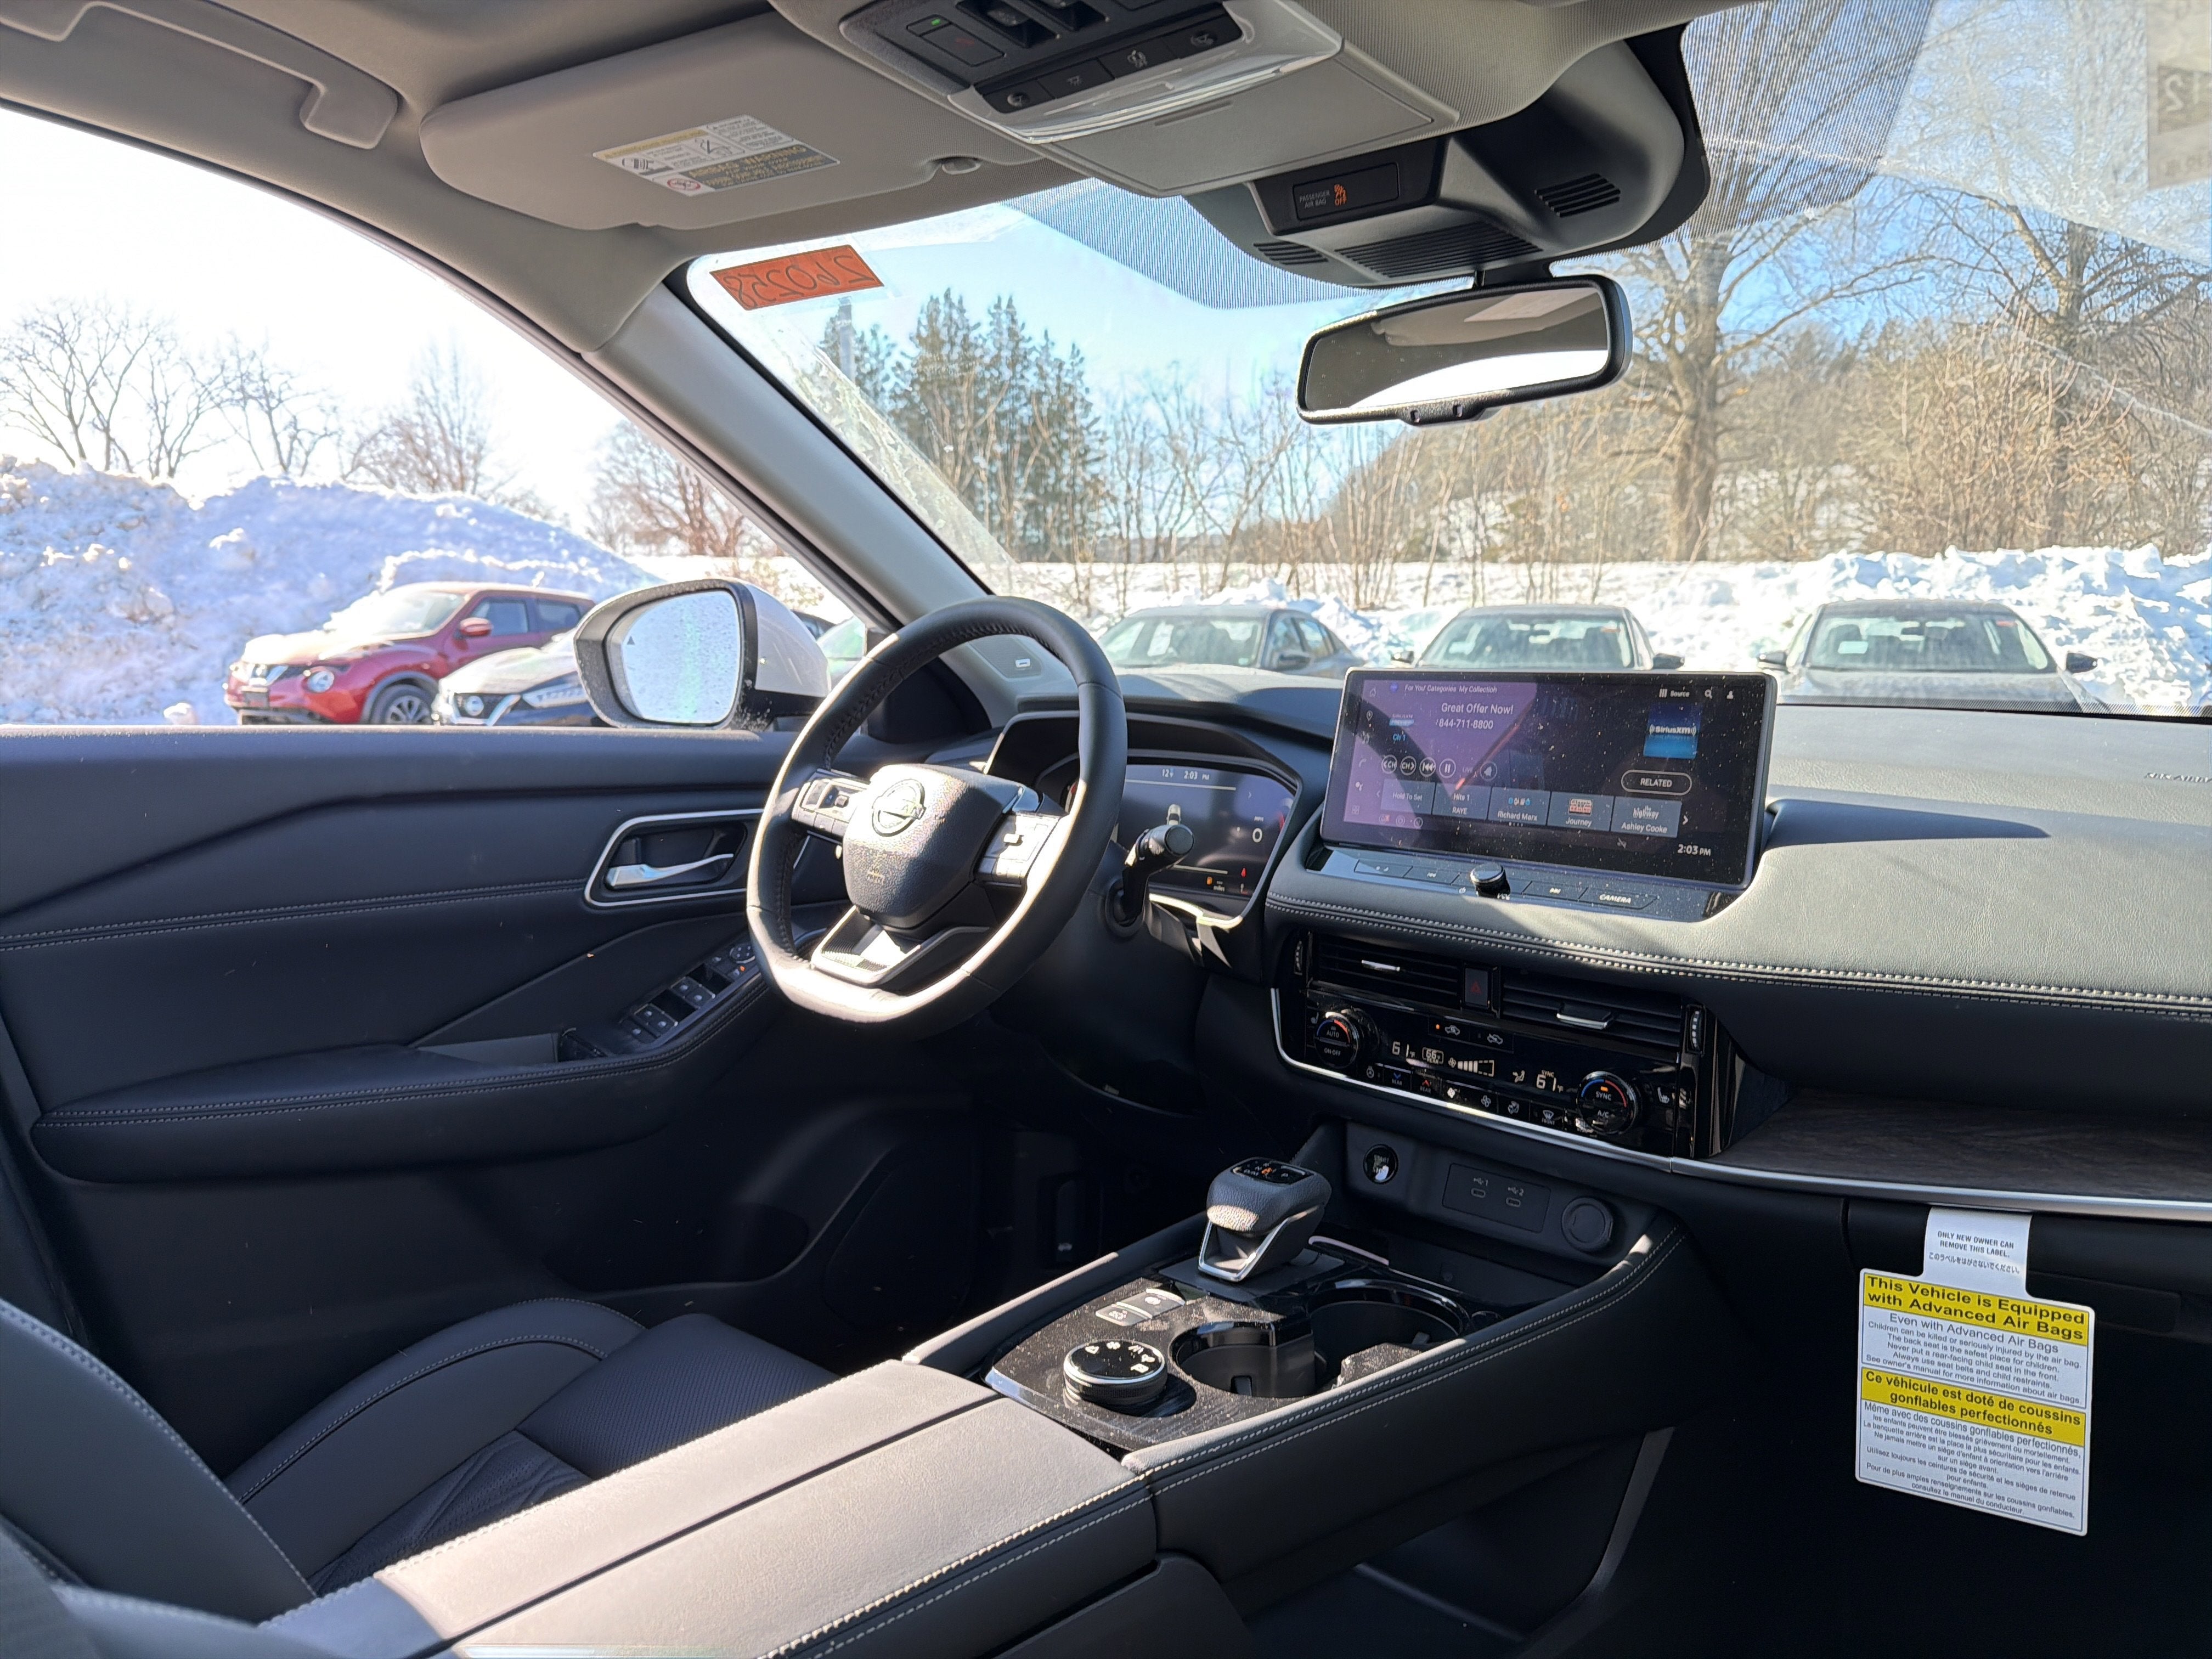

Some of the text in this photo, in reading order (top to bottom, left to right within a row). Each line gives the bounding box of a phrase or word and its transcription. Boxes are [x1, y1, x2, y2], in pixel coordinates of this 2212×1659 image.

[1299, 189, 1330, 203] PASSENGER
[1441, 703, 1514, 714] Great Offer Now!
[1392, 733, 1401, 741] Ch
[1184, 770, 1198, 780] 2:03
[1640, 777, 1672, 788] RELATED
[1392, 792, 1405, 800] Hold
[1452, 806, 1468, 815] RAYE
[1497, 810, 1538, 821] Richard Marx
[1633, 807, 1659, 820] highway
[1565, 816, 1592, 827] Journey
[1621, 821, 1668, 833] Ashley Cooke
[1252, 828, 1262, 843] 0
[1677, 844, 1711, 856] 2:03 PM
[1599, 894, 1632, 904] CAMERA
[1326, 1030, 1340, 1038] AUTO
[1542, 1069, 1554, 1078] SYNC
[1595, 1091, 1612, 1101] SYNC
[1597, 1110, 1610, 1119] A/C
[1938, 1231, 2014, 1249] ONLY NEW OWNER CAN
[1940, 1240, 2010, 1258] REMOVE THIS LABEL.
[1867, 1276, 2084, 1324] This Vehicle is Equipped
[1867, 1293, 2083, 1340] with Advanced Air Bags
[1890, 1312, 2058, 1353] Even with Advanced Air Bags
[1868, 1321, 1898, 1333] Children
[1900, 1328, 1914, 1336] can
[1916, 1329, 1925, 1338] be
[1928, 1331, 1947, 1342] killed
[1959, 1339, 1993, 1352] seriously
[1995, 1345, 2022, 1357] injured
[2024, 1350, 2034, 1360] by
[2036, 1352, 2049, 1362] the
[2064, 1357, 2081, 1369] bag.
[1887, 1332, 2059, 1373] The back seat is the safest place for children.
[1887, 1341, 1909, 1352] Never
[1911, 1347, 1923, 1355] put
[1932, 1351, 1972, 1366] rear-facing
[1975, 1359, 1993, 1369] child
[1995, 1364, 2012, 1373] seat
[2014, 1365, 2021, 1375] in
[2023, 1368, 2036, 1378] the
[2039, 1370, 2058, 1381] front.
[1893, 1351, 2051, 1389] Always use seat belts and child restraints.
[1866, 1353, 1880, 1363] See
[1882, 1358, 1911, 1369] owner's
[1913, 1364, 1940, 1375] manual
[1943, 1369, 1953, 1378] for
[1955, 1373, 1974, 1382] more
[1977, 1376, 2020, 1392] information
[2022, 1386, 2045, 1397] about
[2059, 1393, 2081, 1404] bags.
[1866, 1370, 2080, 1425] Ce véhicule est doté de coussins
[1890, 1392, 2052, 1434] gonflables perfectionnés
[1864, 1401, 2080, 1459] Même avec des coussins gonflables perfectionnés,
